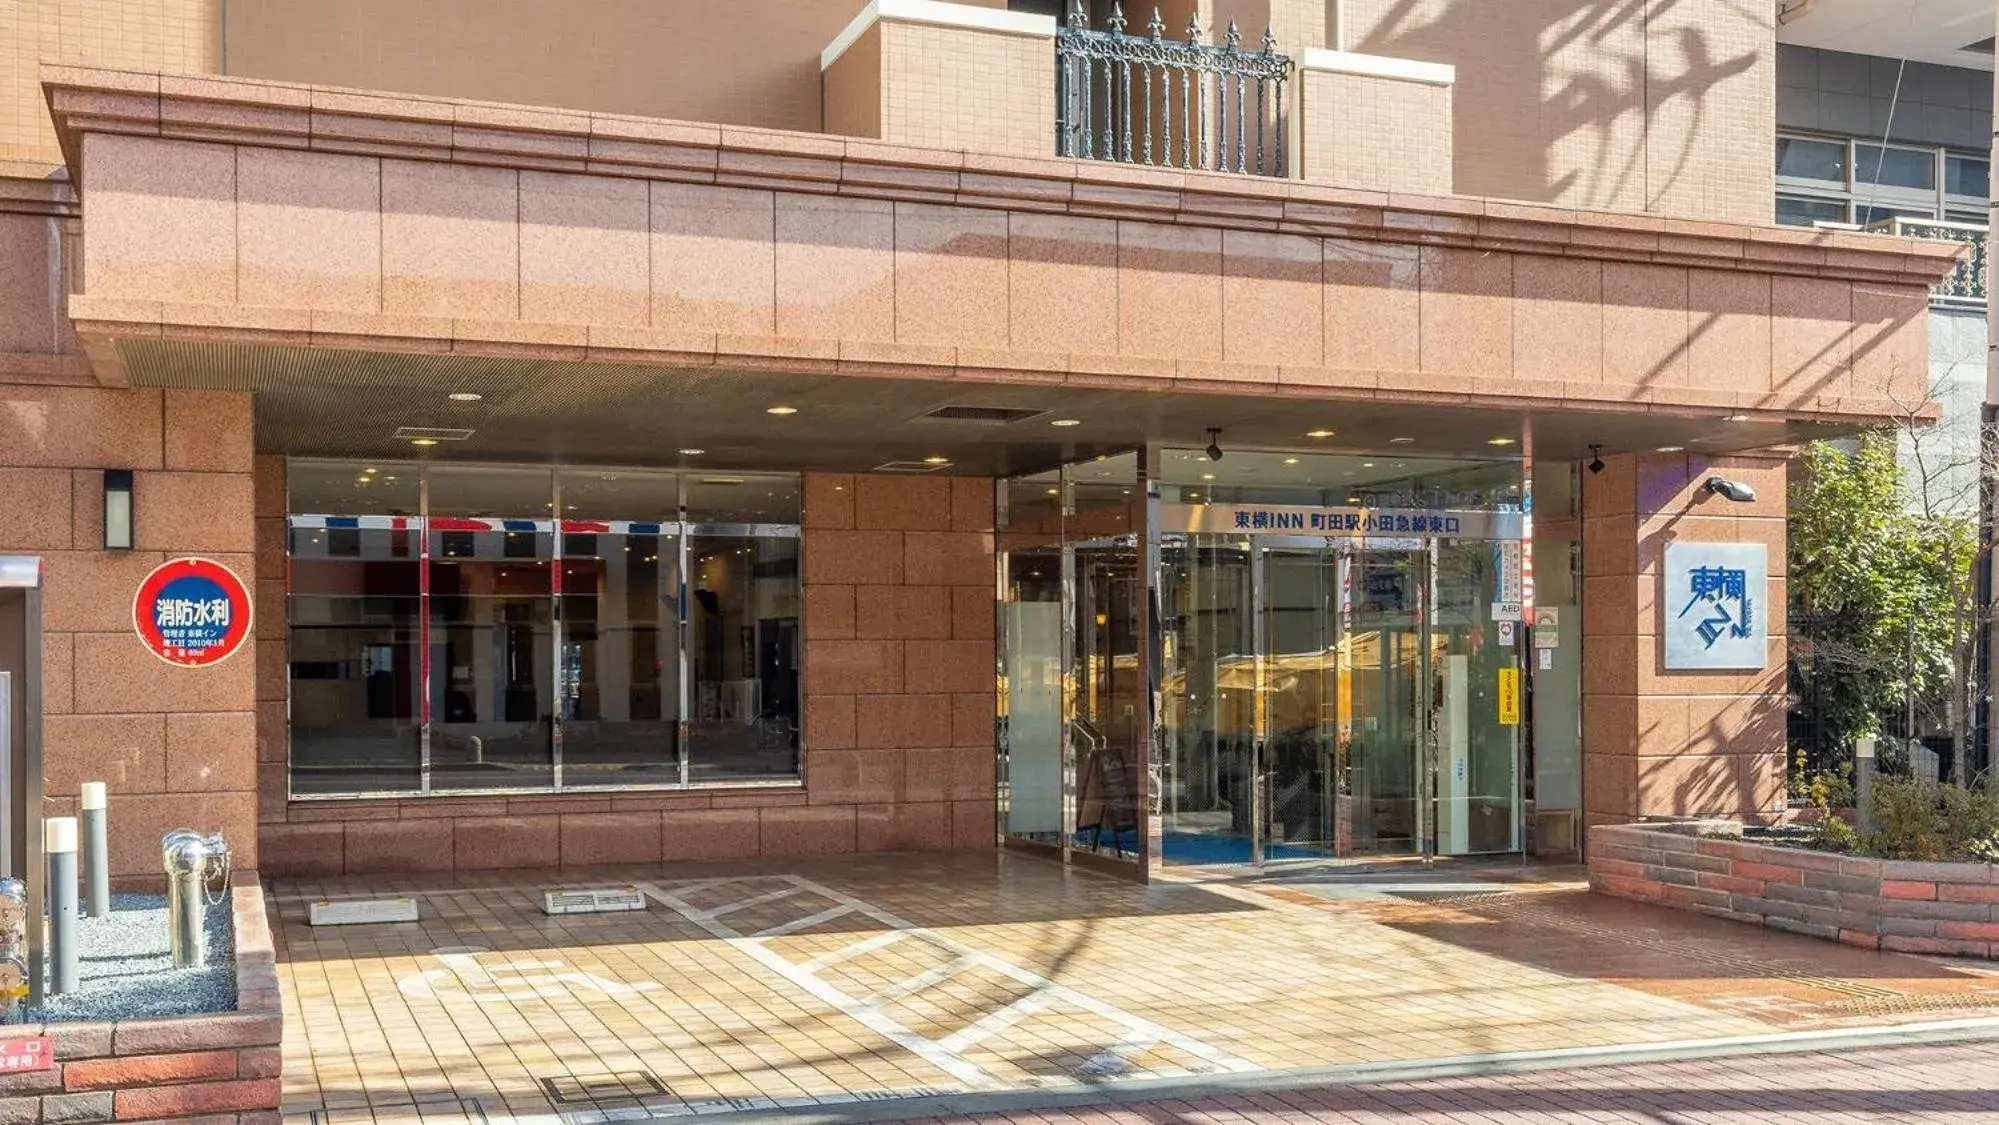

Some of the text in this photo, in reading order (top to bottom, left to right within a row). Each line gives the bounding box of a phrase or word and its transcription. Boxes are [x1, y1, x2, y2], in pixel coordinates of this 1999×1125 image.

[1234, 510, 1460, 533] 東横INN 町田駅小田急線東口
[156, 598, 229, 627] 消防水利
[1501, 604, 1520, 613] AED
